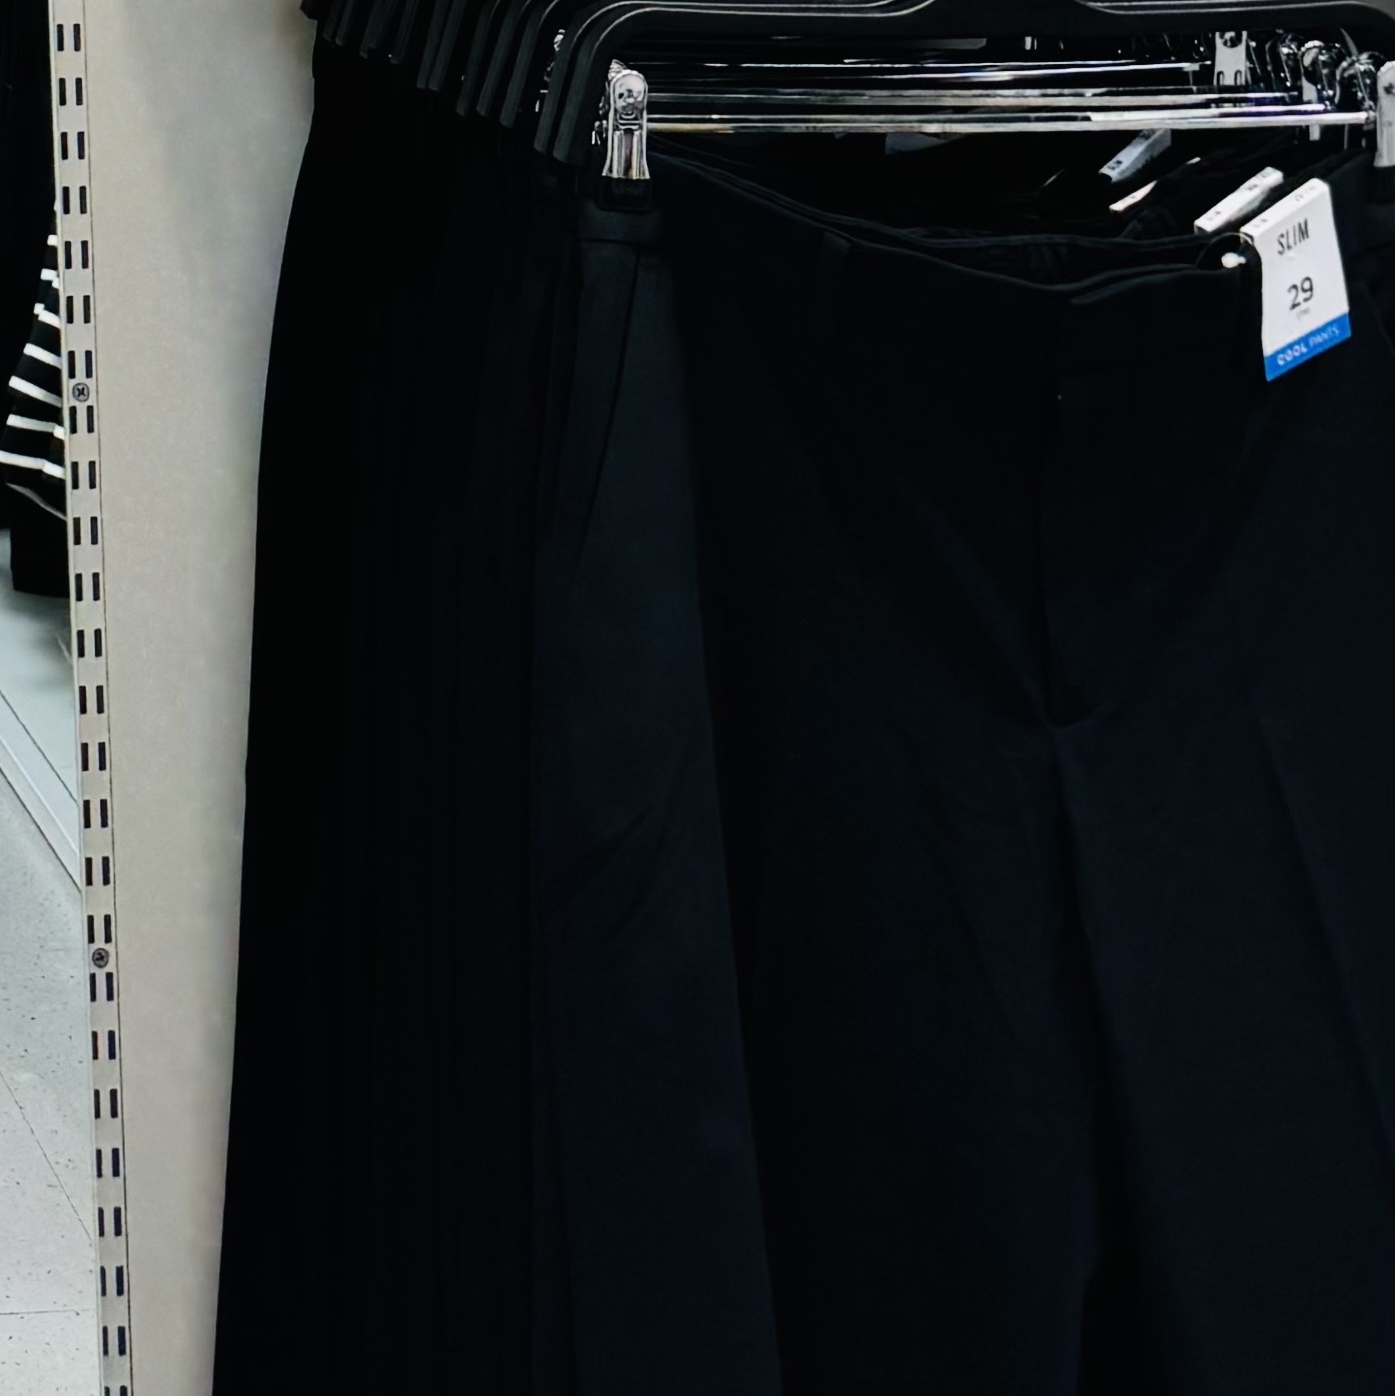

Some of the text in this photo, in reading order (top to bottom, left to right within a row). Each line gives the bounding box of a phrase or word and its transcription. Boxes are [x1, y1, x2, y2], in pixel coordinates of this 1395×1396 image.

[1276, 218, 1310, 256] SLIM
[1287, 276, 1314, 311] 29
[1276, 323, 1340, 366] COOL PANTS
